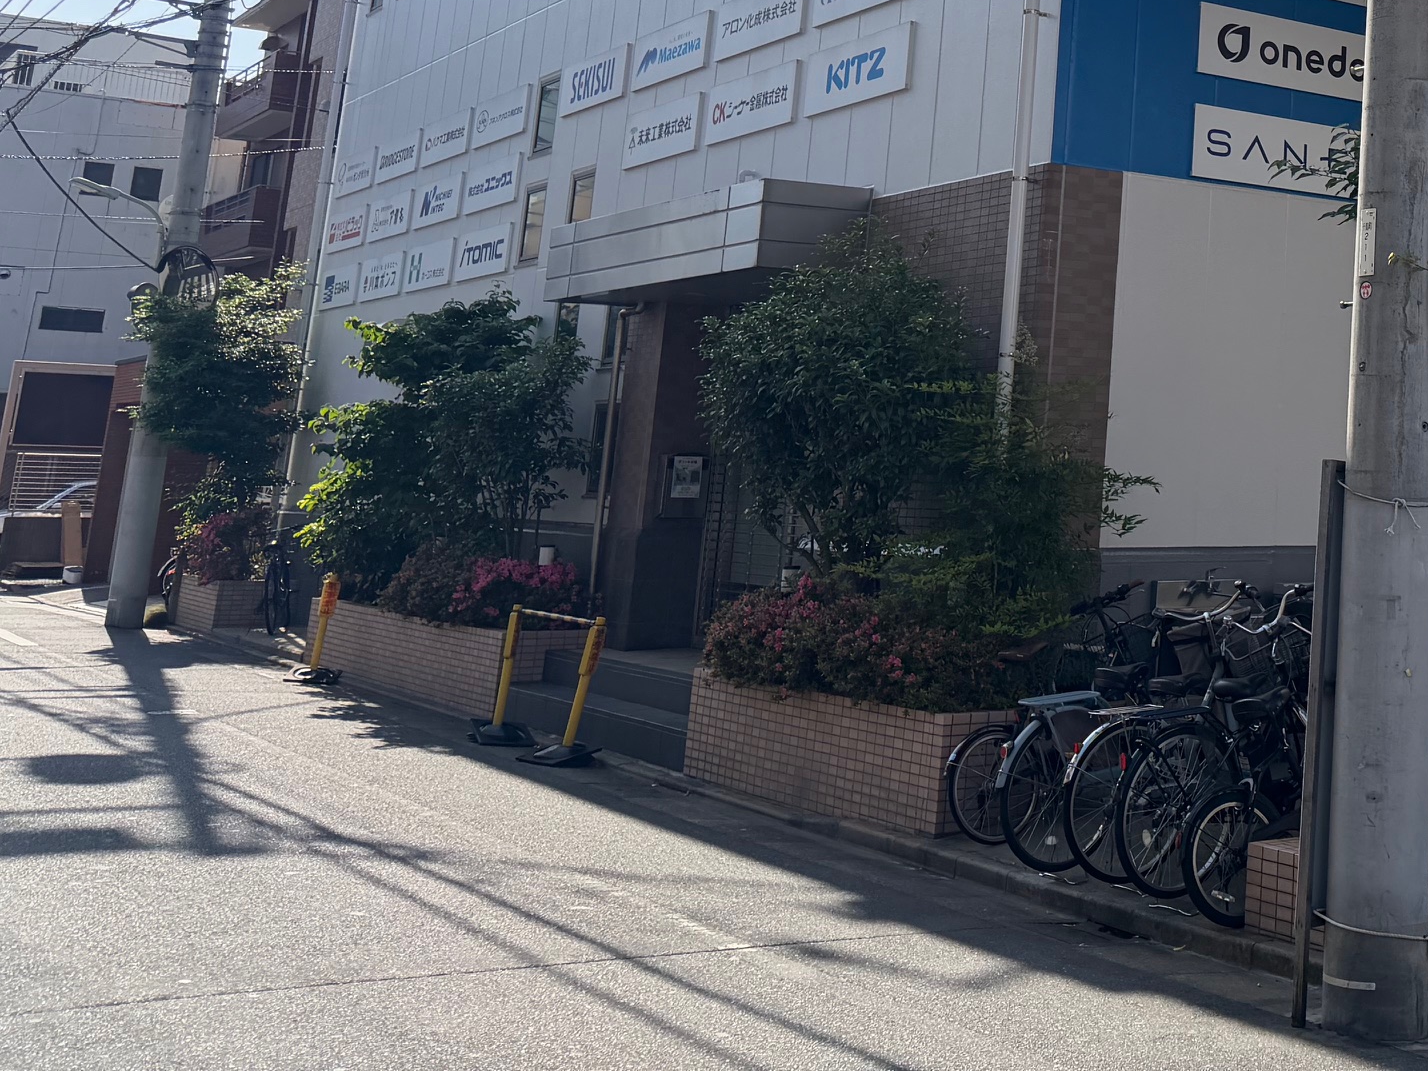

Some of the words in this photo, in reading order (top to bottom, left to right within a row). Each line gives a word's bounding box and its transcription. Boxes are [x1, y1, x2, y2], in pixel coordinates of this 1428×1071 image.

[658, 37, 701, 65] Maezawa
[570, 57, 616, 105] SEKISUI
[825, 46, 887, 95] KITZ
[637, 113, 692, 146] 未来工業株式会社
[334, 280, 350, 296] EBARA
